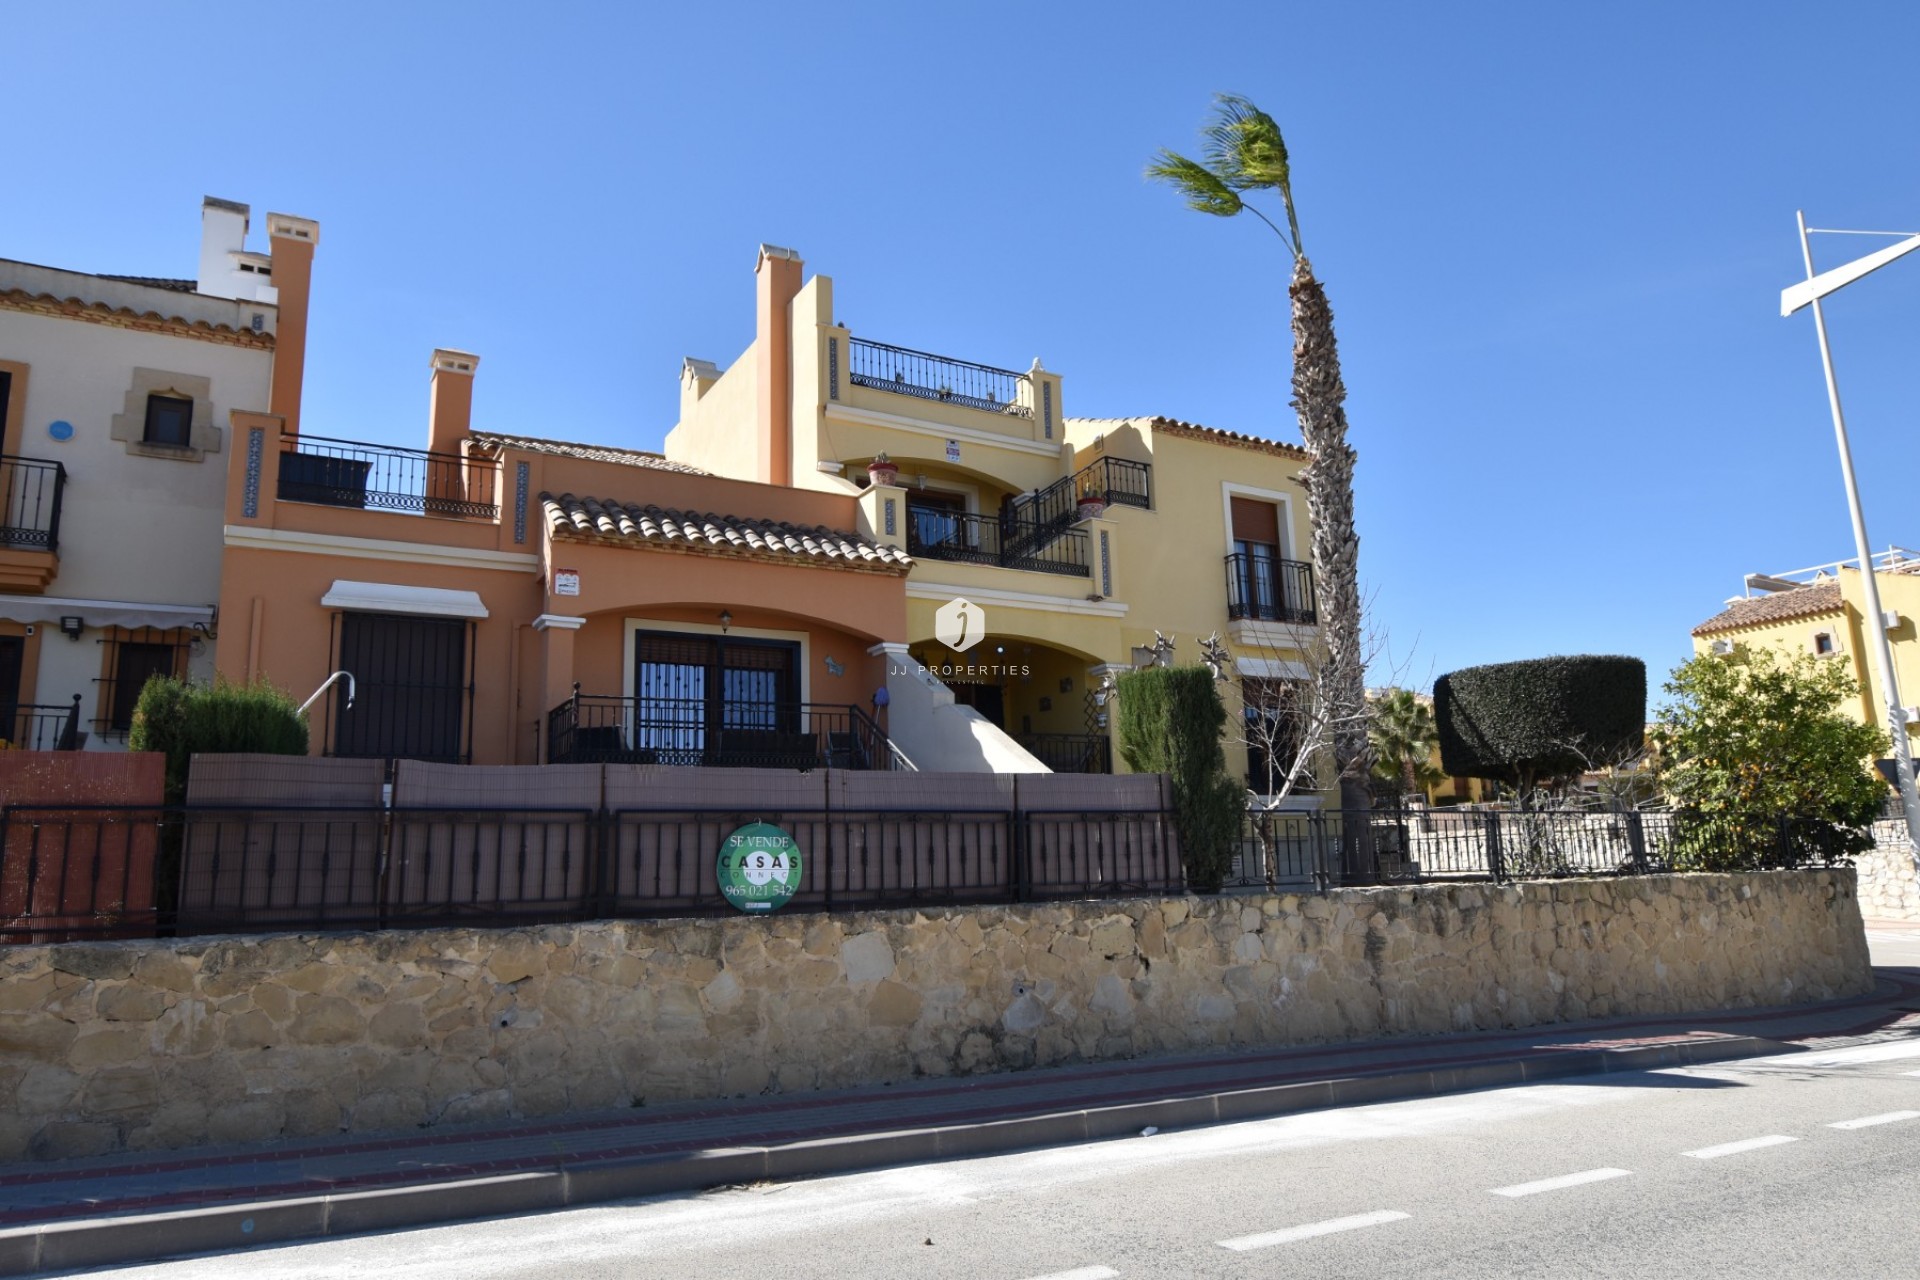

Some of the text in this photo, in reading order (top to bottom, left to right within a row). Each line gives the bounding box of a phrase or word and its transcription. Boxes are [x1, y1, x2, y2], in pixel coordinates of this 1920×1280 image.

[729, 836, 789, 848] SE VENDE
[721, 856, 798, 868] CASAS
[720, 871, 798, 879] CONNECT
[725, 885, 792, 897] 965 021 542
